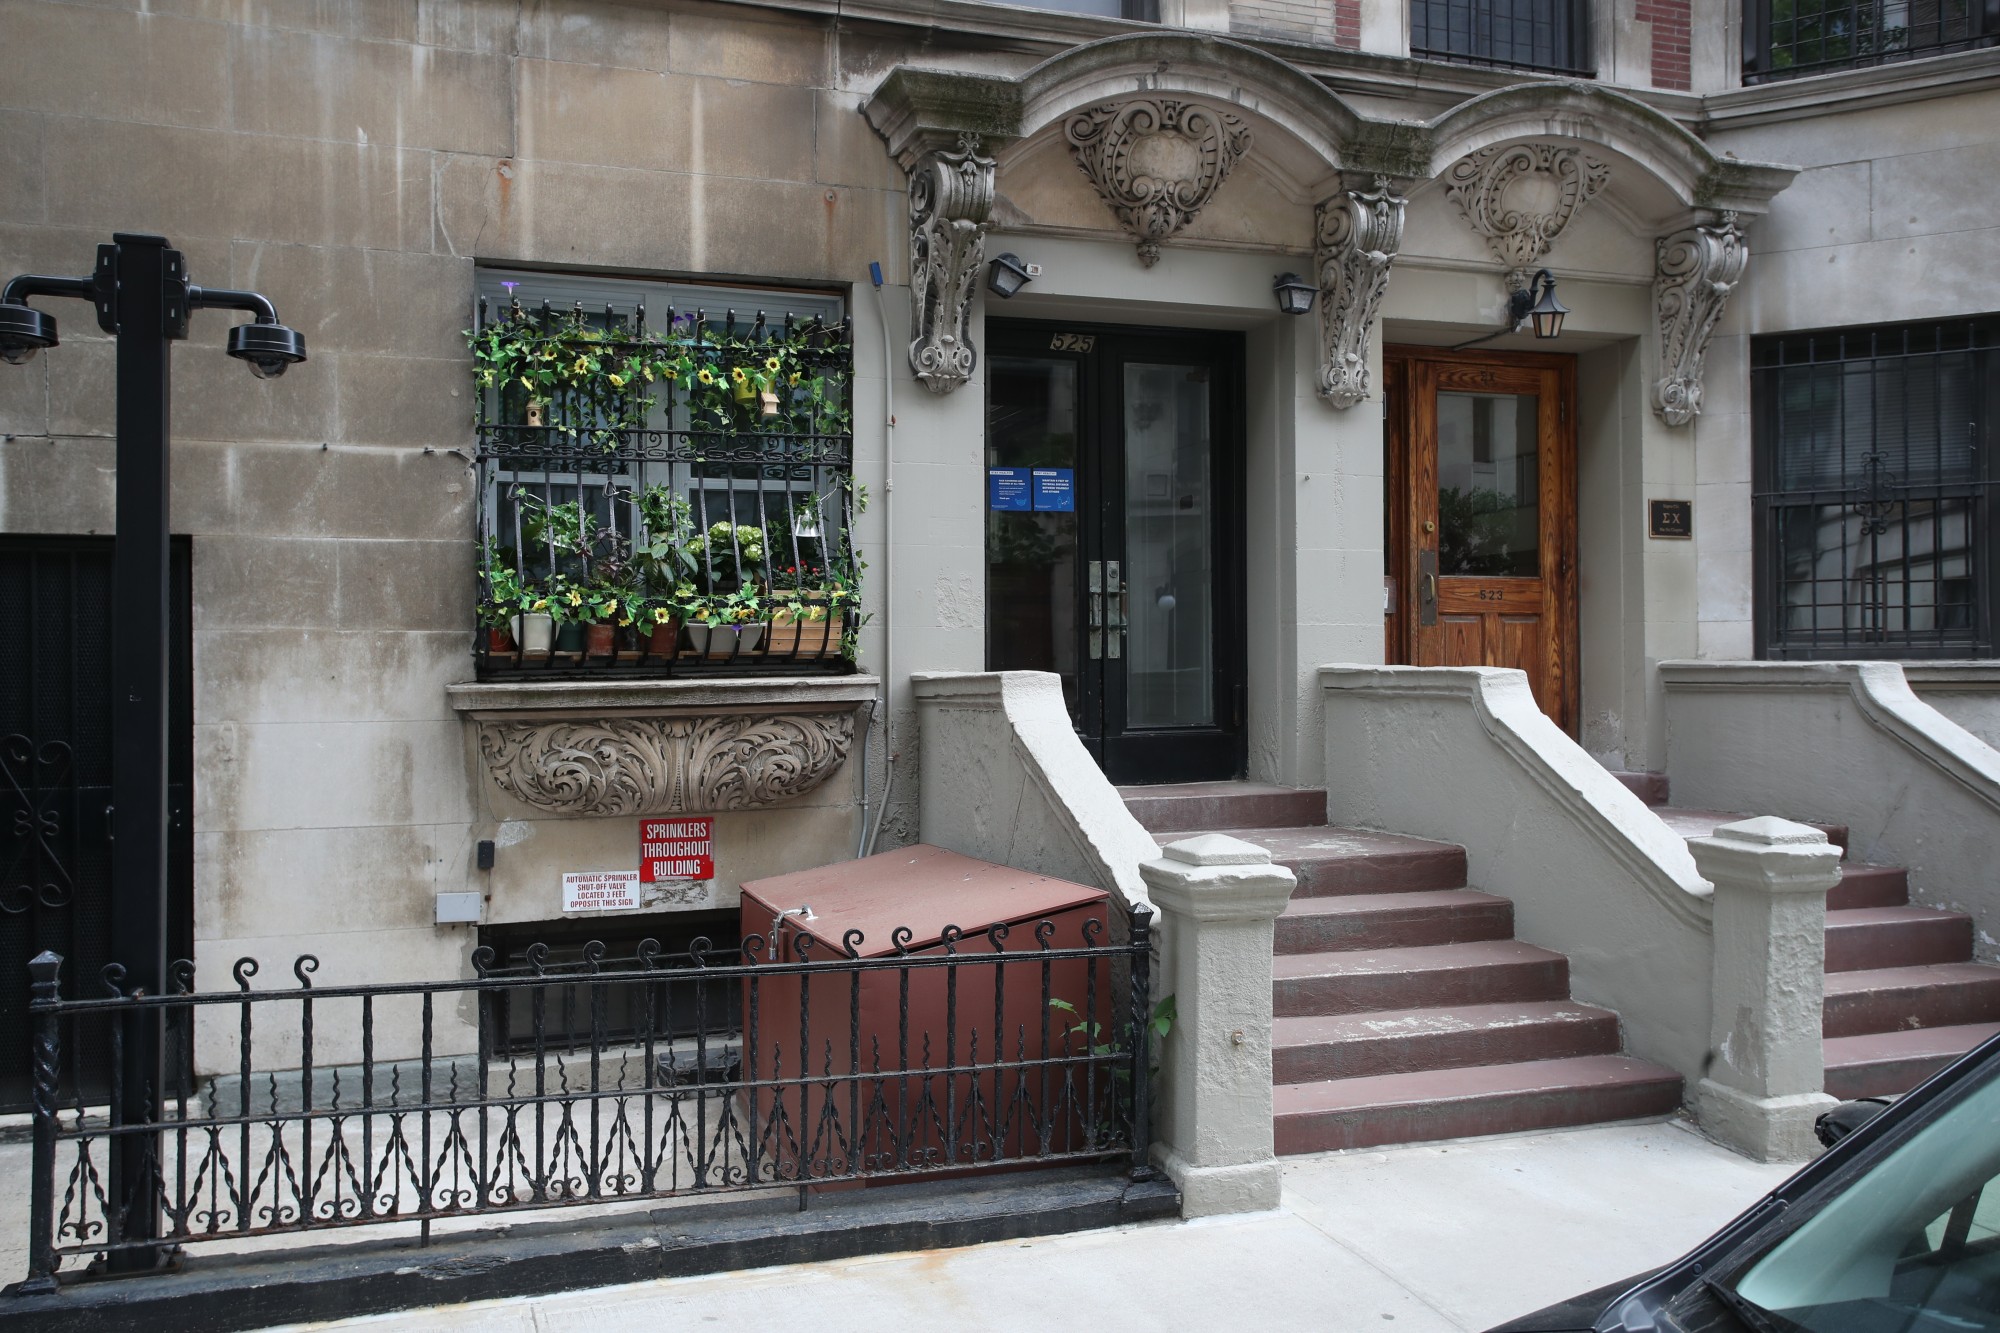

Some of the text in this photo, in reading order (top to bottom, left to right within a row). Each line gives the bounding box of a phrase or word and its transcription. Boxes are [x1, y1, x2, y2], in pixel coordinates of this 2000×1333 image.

[1053, 333, 1093, 352] 525
[1480, 589, 1503, 600] 523
[647, 822, 707, 839] SPRINKLERS
[643, 840, 710, 858] THROUGHOUT
[653, 859, 701, 876] BUILDING
[566, 873, 638, 883] AUTOMATIC SPRINKLER
[577, 882, 626, 891] SHUT-OFF VALVE
[577, 891, 605, 900] LOCATED
[612, 890, 626, 898] FEET
[570, 900, 600, 908] OPPOSITE
[618, 898, 633, 906] SIGN
